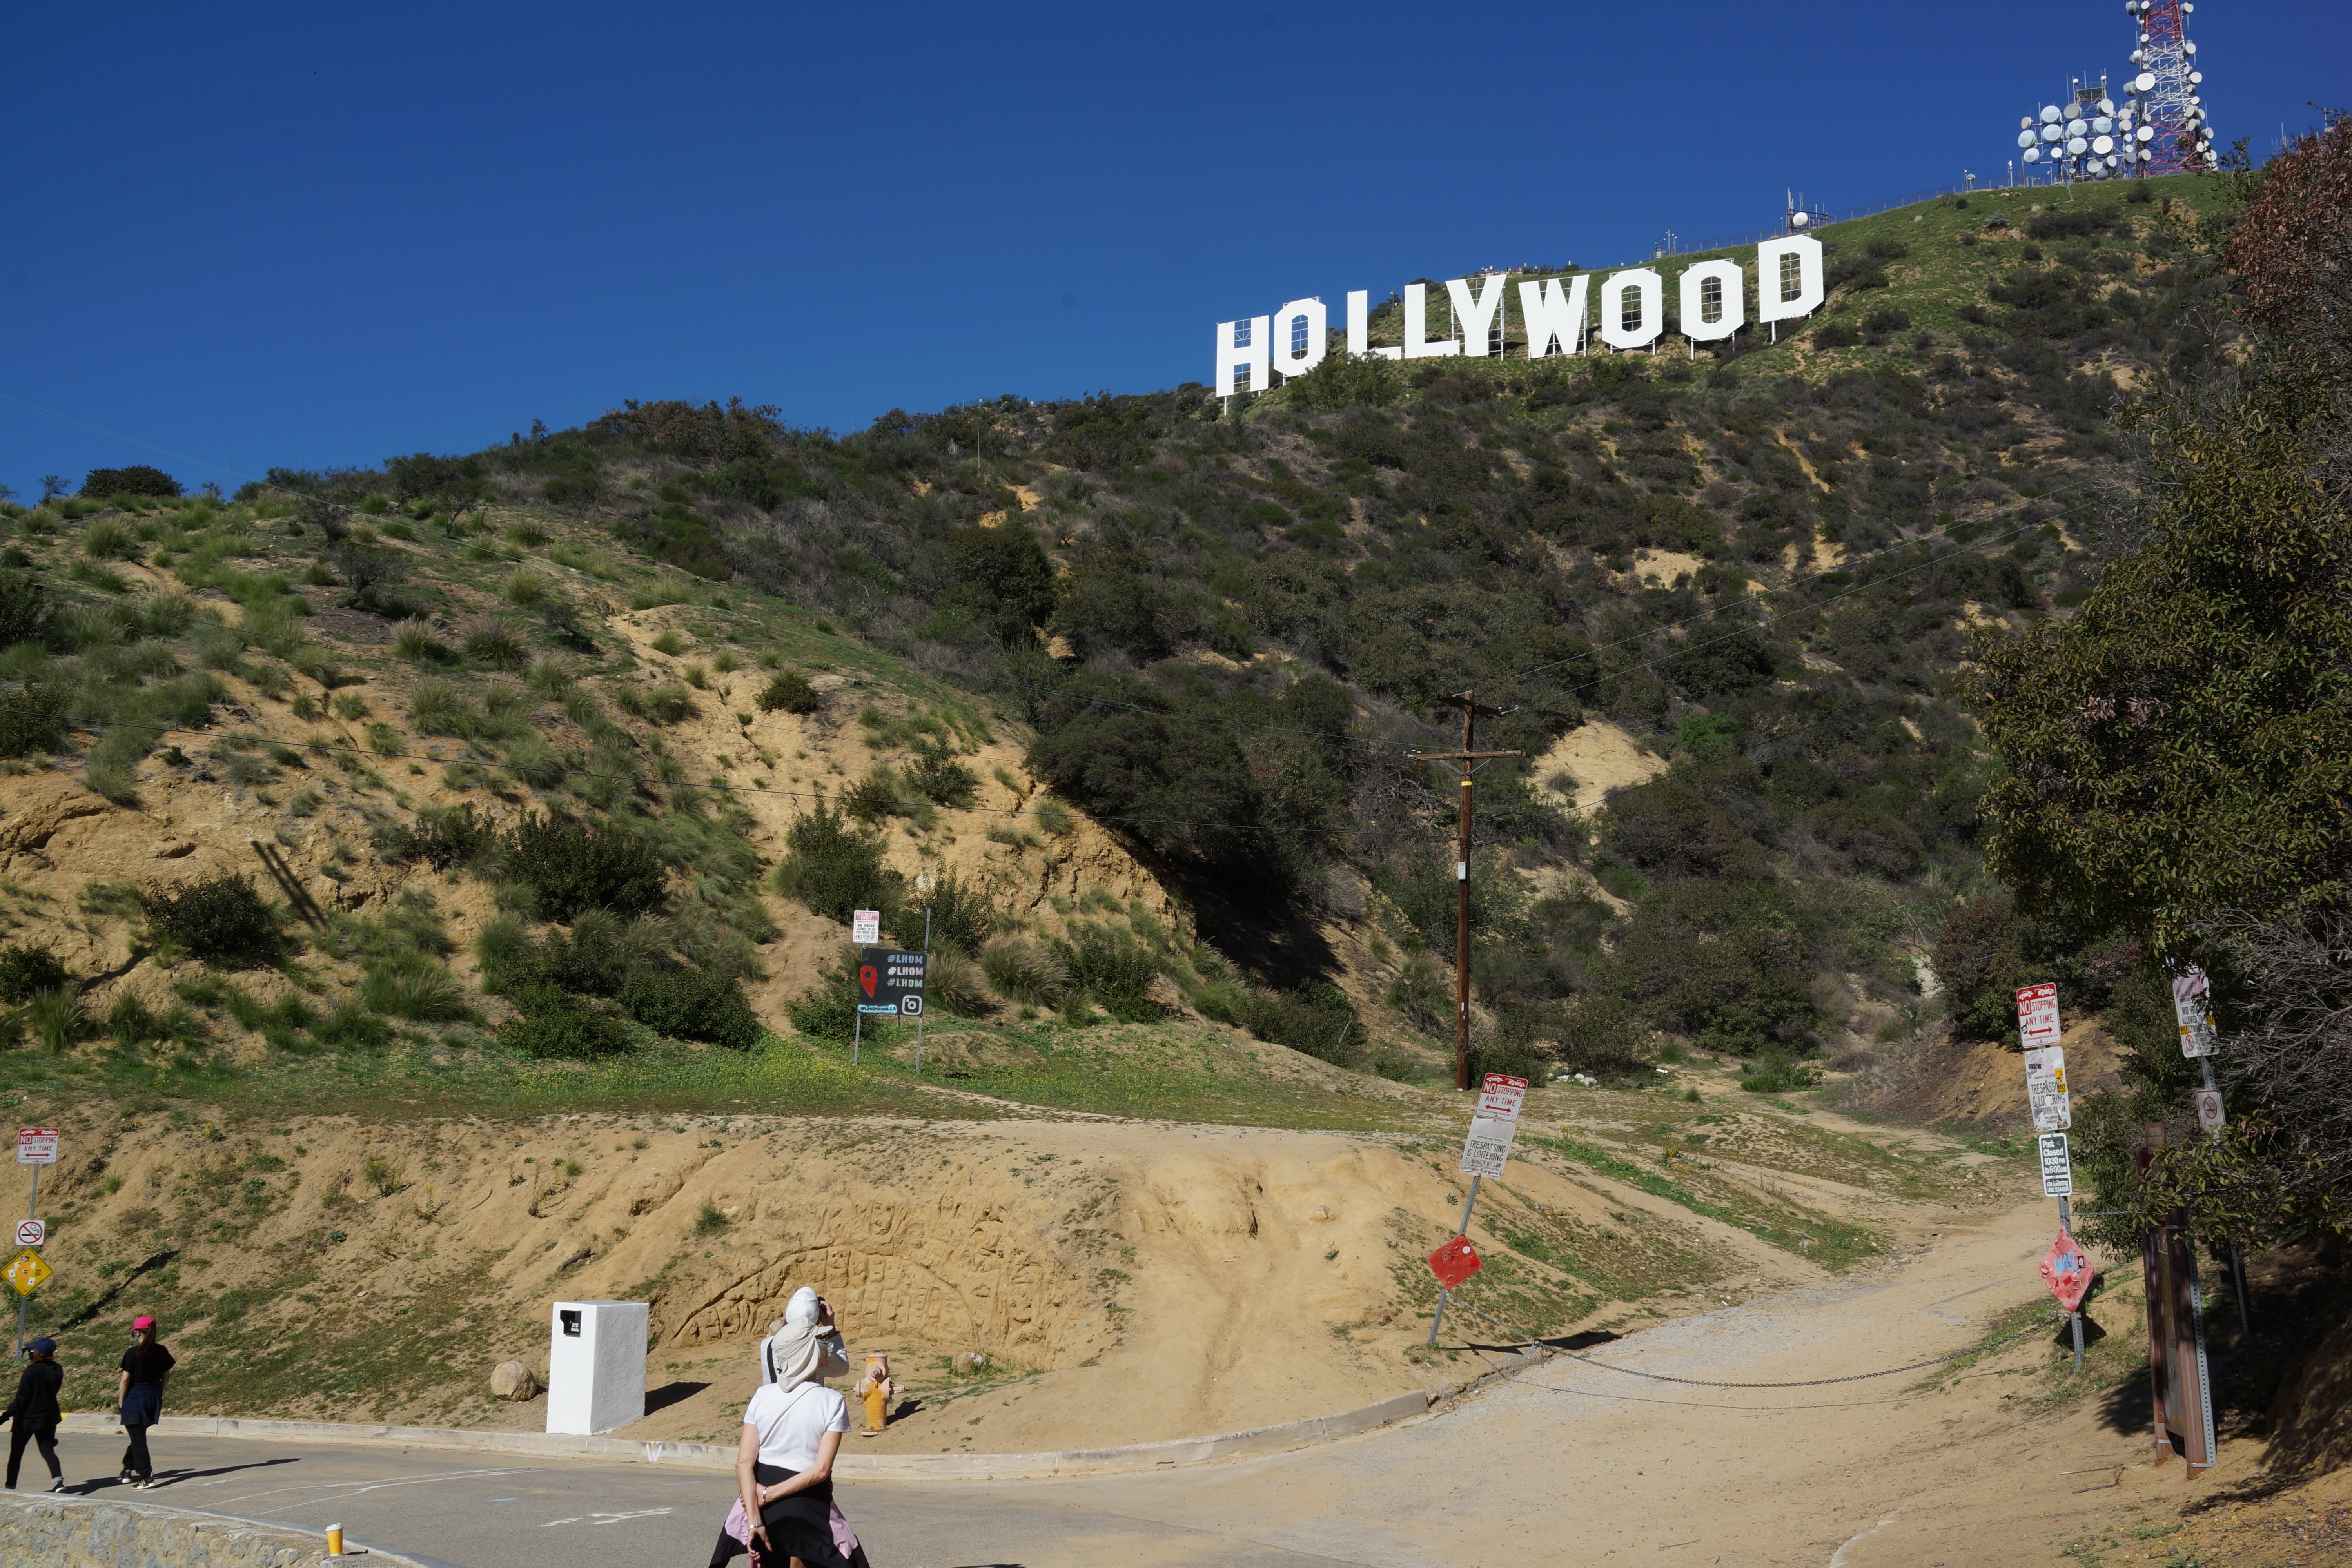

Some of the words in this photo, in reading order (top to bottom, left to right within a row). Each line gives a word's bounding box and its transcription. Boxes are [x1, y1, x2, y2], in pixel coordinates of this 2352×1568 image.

[1216, 234, 1824, 396] HOLLYWOOD
[887, 954, 923, 964] #LHOM
[888, 967, 923, 976] #LHOM
[887, 978, 922, 988] #LHOM
[2019, 1000, 2031, 1015] NO
[2032, 998, 2056, 1012] STOPPING
[2181, 1006, 2189, 1015] NO
[2025, 1016, 2037, 1026] ANY
[2039, 1013, 2054, 1024] TIME
[1483, 1082, 1496, 1093] NO
[1497, 1086, 1523, 1098] STOPPING
[2031, 1080, 2063, 1094] TRESPASSI
[1485, 1095, 1499, 1103] ANY
[1501, 1098, 1517, 1106] TIME
[2033, 1096, 2037, 1107] &
[2038, 1093, 2065, 1106] LORING
[20, 1135, 31, 1144] NO
[2042, 1140, 2055, 1148] Park
[1467, 1148, 1472, 1156] &
[1474, 1149, 1504, 1162] LOITERING
[2043, 1147, 2064, 1157] Closed
[2044, 1156, 2058, 1165] 10:30
[2049, 1165, 2061, 1173] 5:00
